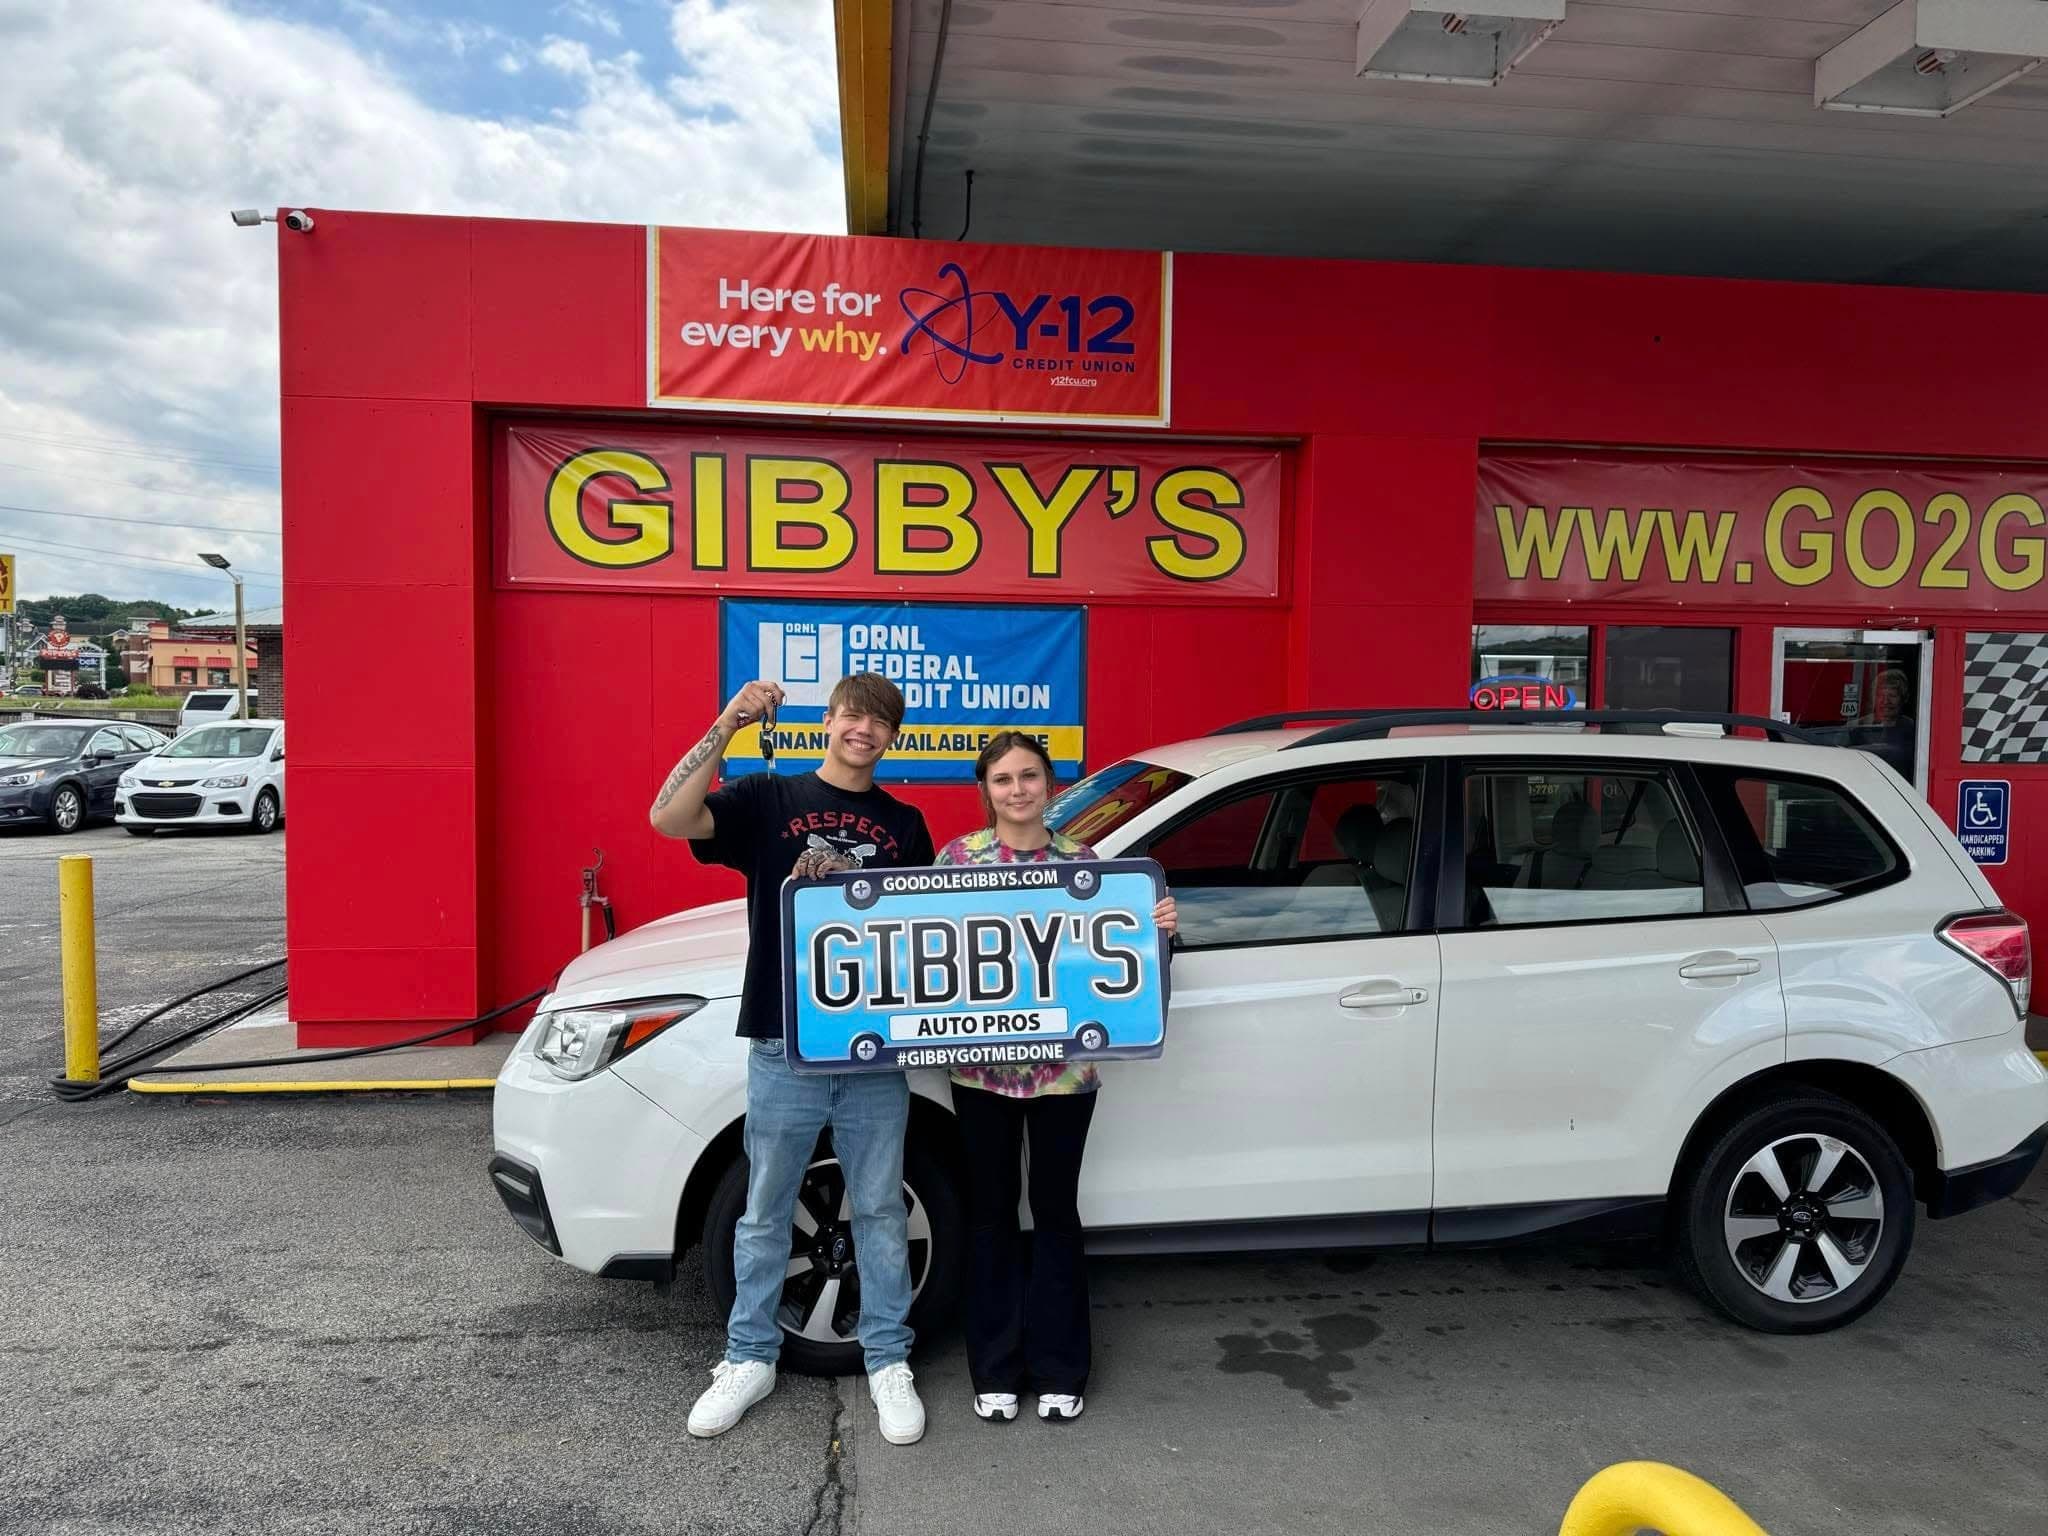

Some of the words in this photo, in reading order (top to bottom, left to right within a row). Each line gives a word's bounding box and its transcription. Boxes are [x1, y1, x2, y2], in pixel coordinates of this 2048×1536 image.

[718, 278, 817, 315] Here
[822, 282, 881, 317] for
[999, 293, 1136, 355] Y-12
[681, 320, 793, 358] every
[800, 321, 887, 362] why.
[1012, 358, 1074, 371] CREDIT
[1082, 360, 1135, 373] UNION
[1050, 376, 1097, 387] y12fcu.org
[545, 447, 1247, 582] GIBBY'S
[785, 623, 817, 633] ORNL
[850, 624, 925, 651] ORNL
[850, 653, 979, 680] FEDERAL
[961, 684, 1050, 709] UNION
[1474, 684, 1565, 711] OPEN
[887, 733, 989, 751] VAILABLE
[789, 811, 898, 850] RESPECT
[1960, 834, 2005, 845] HANDICAPPED
[1968, 847, 1996, 857] PARKING
[883, 870, 1058, 892] GOODOLEGIBBYS.COM
[811, 909, 1142, 1011] GIBBY'S
[917, 1016, 978, 1037] AUTO
[983, 1013, 1041, 1032] PROS
[896, 1044, 1064, 1067] #GIBBYGOTMEDONE
